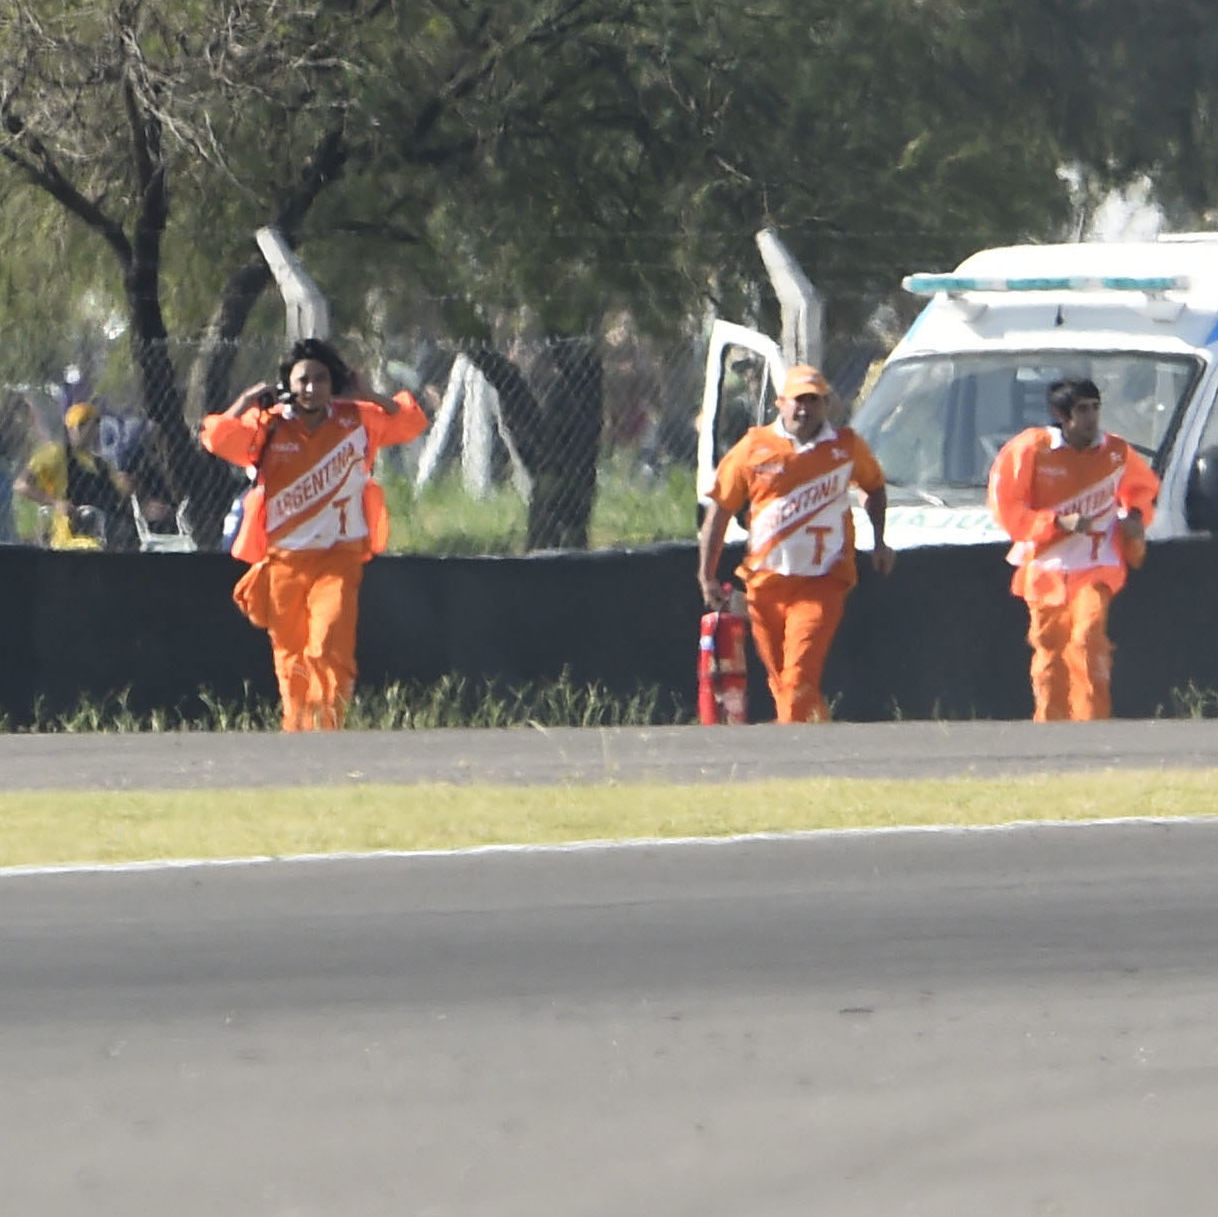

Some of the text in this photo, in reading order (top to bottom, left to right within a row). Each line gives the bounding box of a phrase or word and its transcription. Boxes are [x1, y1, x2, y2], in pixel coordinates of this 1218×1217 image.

[275, 442, 355, 517] ARGENTINA
[332, 494, 352, 535] T
[805, 525, 833, 566] T
[1087, 530, 1107, 560] T
